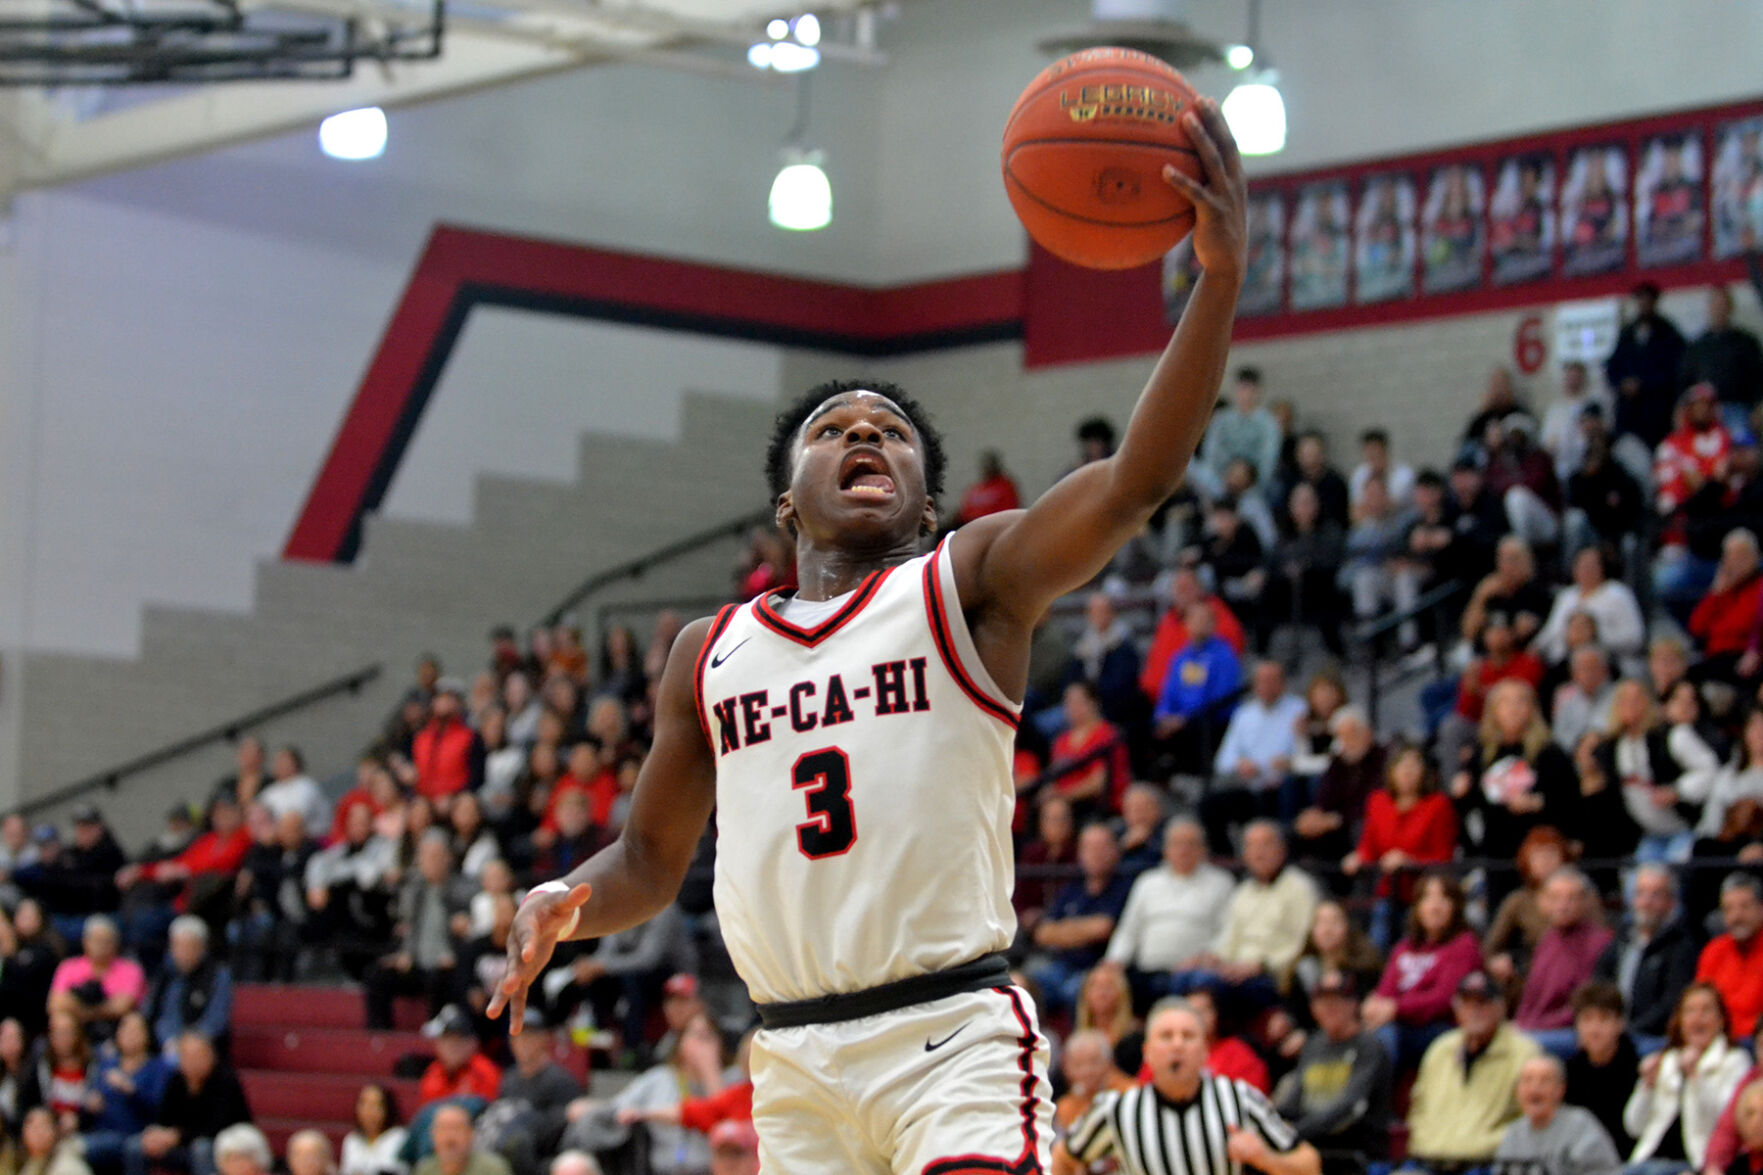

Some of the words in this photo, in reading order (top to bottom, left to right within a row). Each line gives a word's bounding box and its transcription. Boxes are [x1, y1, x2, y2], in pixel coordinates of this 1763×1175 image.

[1514, 317, 1546, 375] 6
[713, 657, 931, 757] NE-CA-HI
[790, 745, 858, 861] 3
